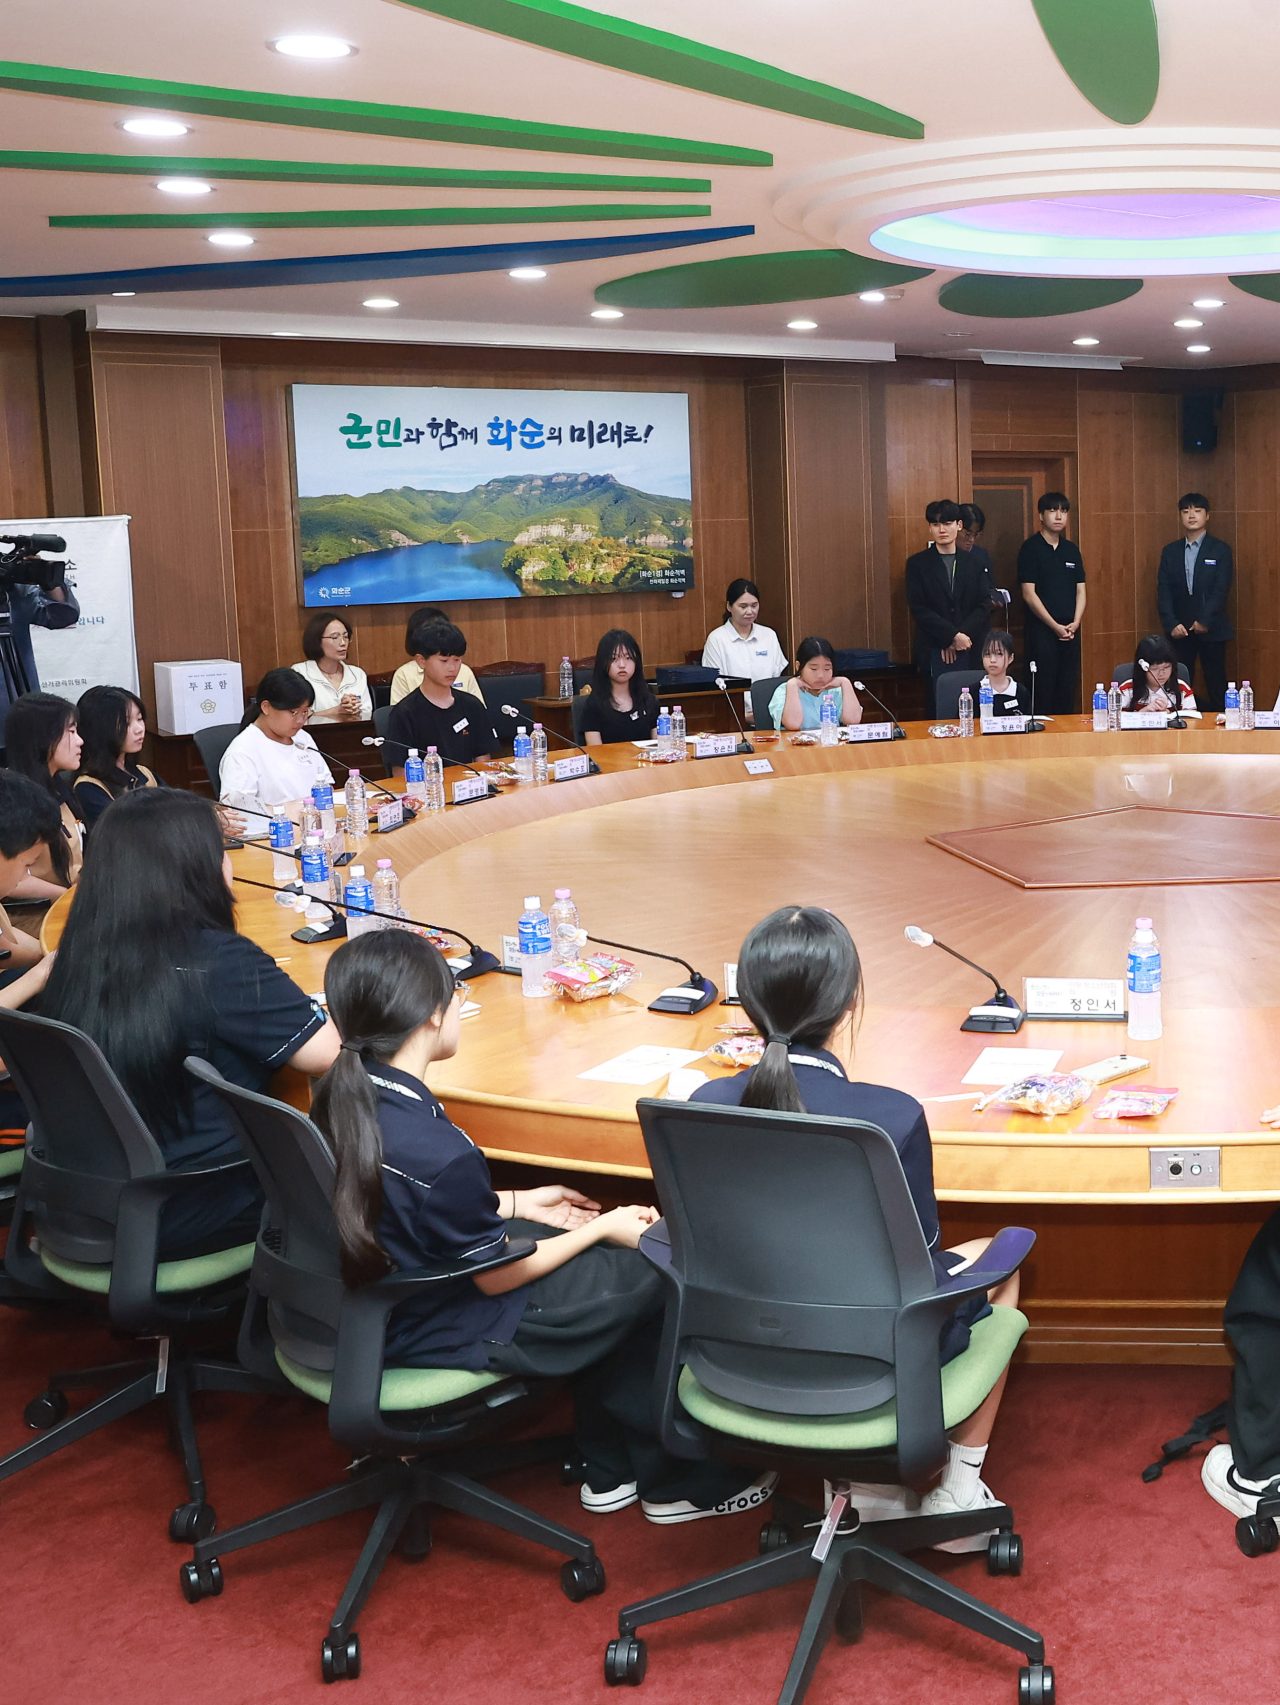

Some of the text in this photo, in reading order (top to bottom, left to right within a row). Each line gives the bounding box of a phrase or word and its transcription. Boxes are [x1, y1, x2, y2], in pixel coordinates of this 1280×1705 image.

[339, 412, 655, 451] 군민과 함께 화순의 미래로!
[1070, 998, 1117, 1012] 정인서
[714, 1486, 769, 1513] crocs
